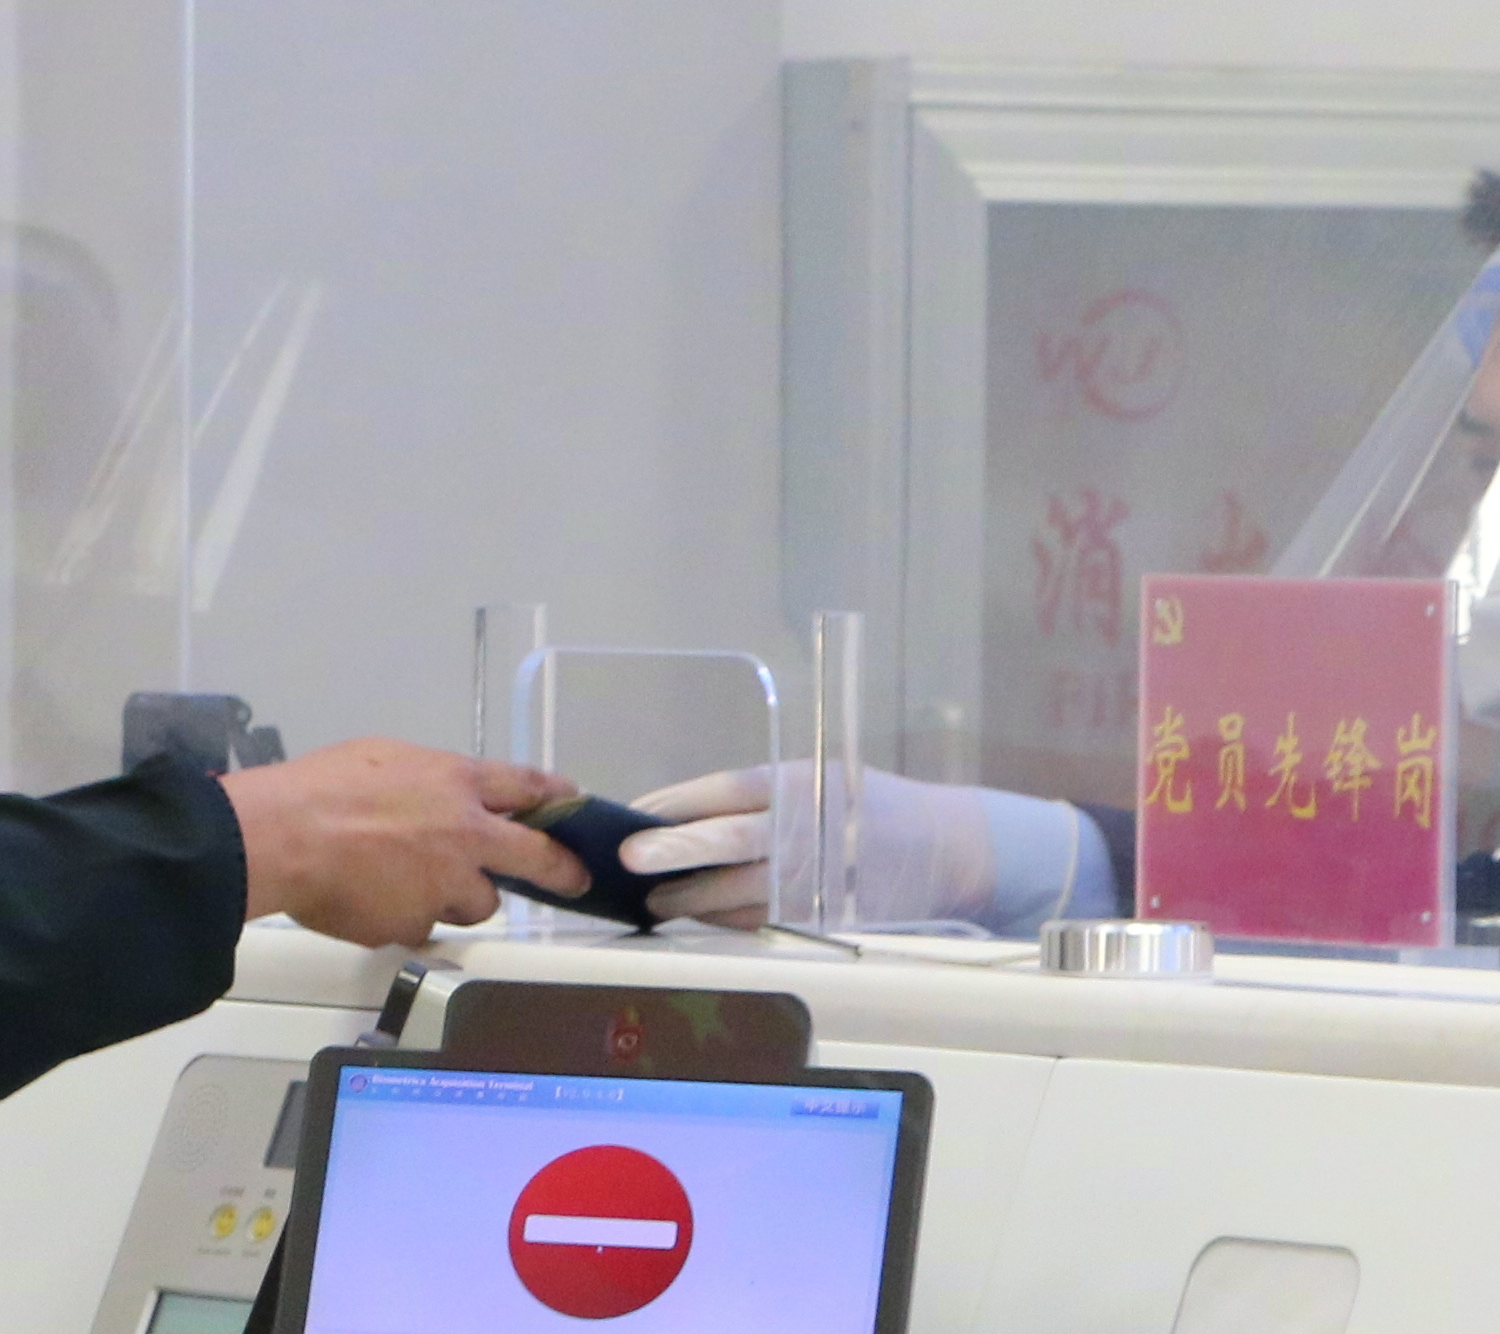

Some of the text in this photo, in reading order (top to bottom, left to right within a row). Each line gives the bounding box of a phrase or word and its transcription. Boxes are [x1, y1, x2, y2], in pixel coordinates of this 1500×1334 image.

[1145, 705, 1437, 829] 党员先锋岗
